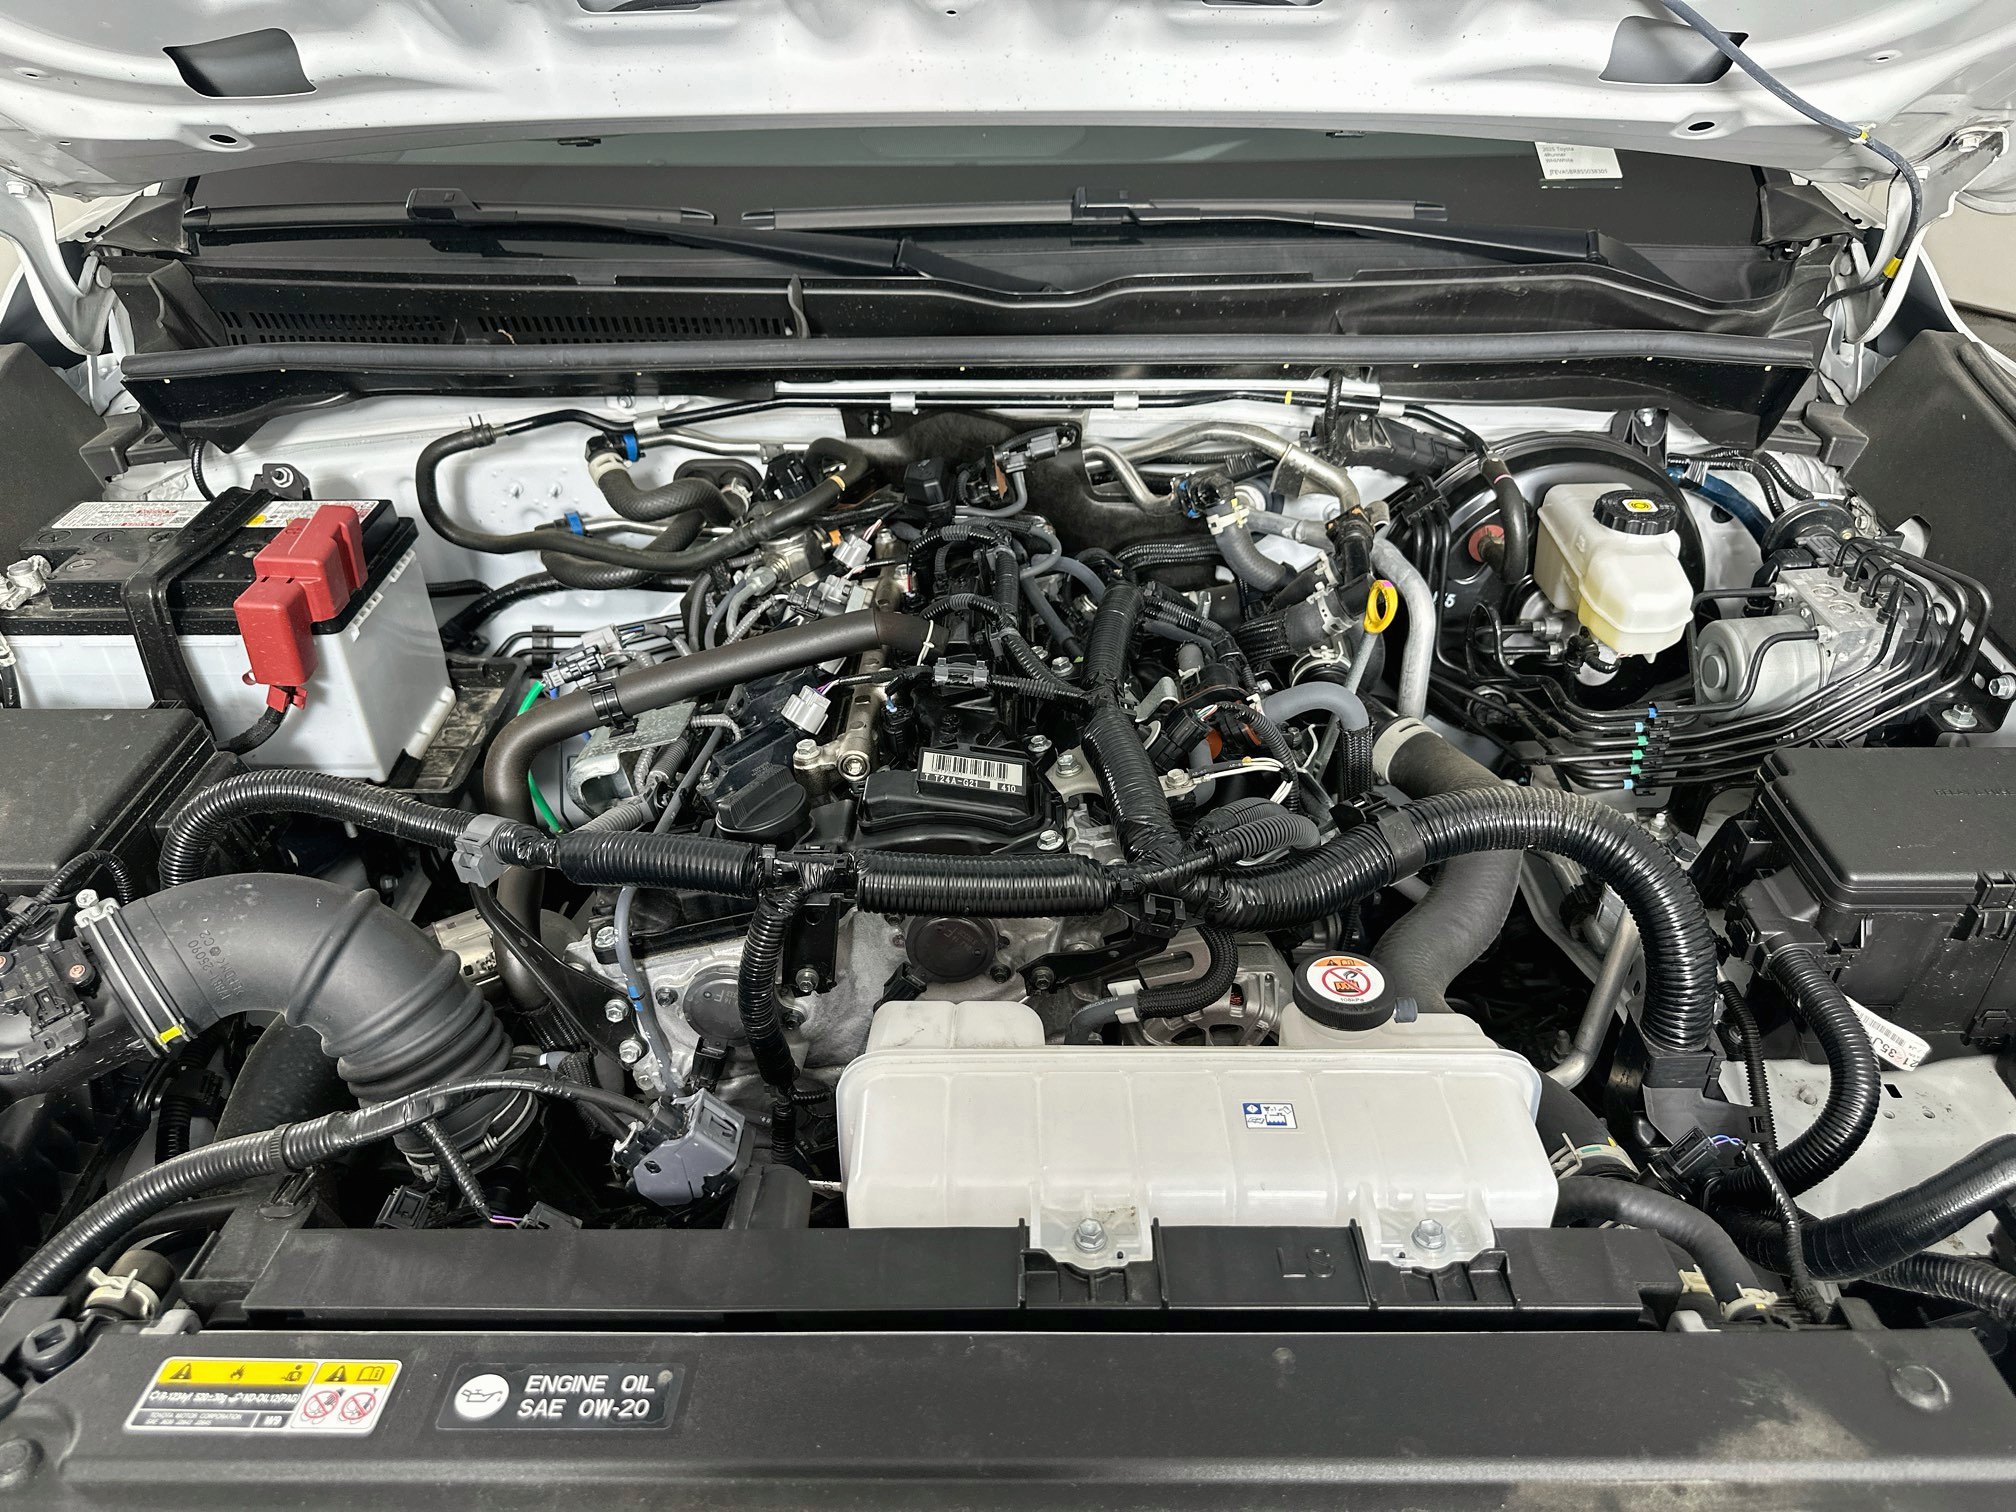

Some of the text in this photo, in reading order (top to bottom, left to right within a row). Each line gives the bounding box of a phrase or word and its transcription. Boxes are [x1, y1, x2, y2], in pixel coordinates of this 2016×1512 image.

[934, 774, 979, 788] T24A-G21
[1000, 784, 1017, 793] 410
[524, 1374, 656, 1394] ENGINE OIL
[516, 1397, 651, 1418] SAE 0W-20
